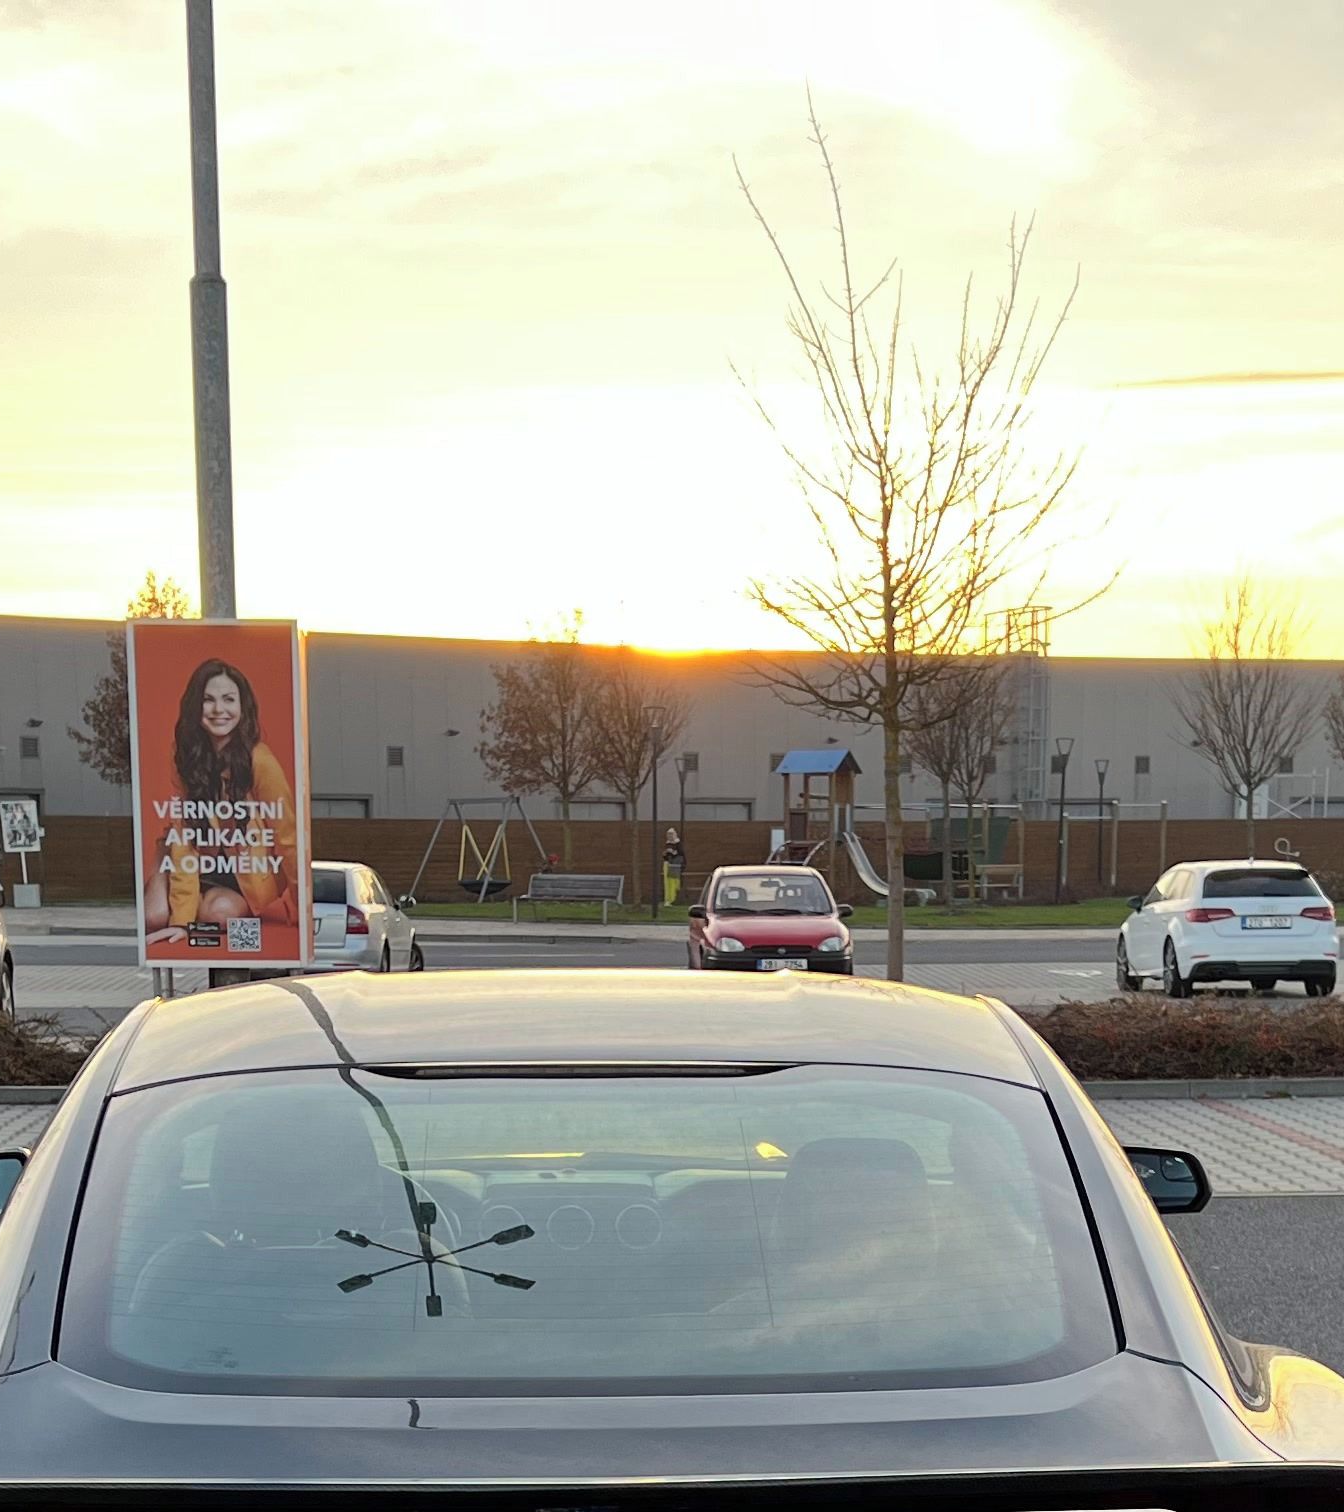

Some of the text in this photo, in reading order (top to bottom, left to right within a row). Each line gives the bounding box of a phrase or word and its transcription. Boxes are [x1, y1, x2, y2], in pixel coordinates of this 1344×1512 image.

[153, 796, 284, 820] VĚRNOSTNÍ
[165, 828, 275, 847] APLIKACE
[159, 851, 283, 874] A ODMĚNY
